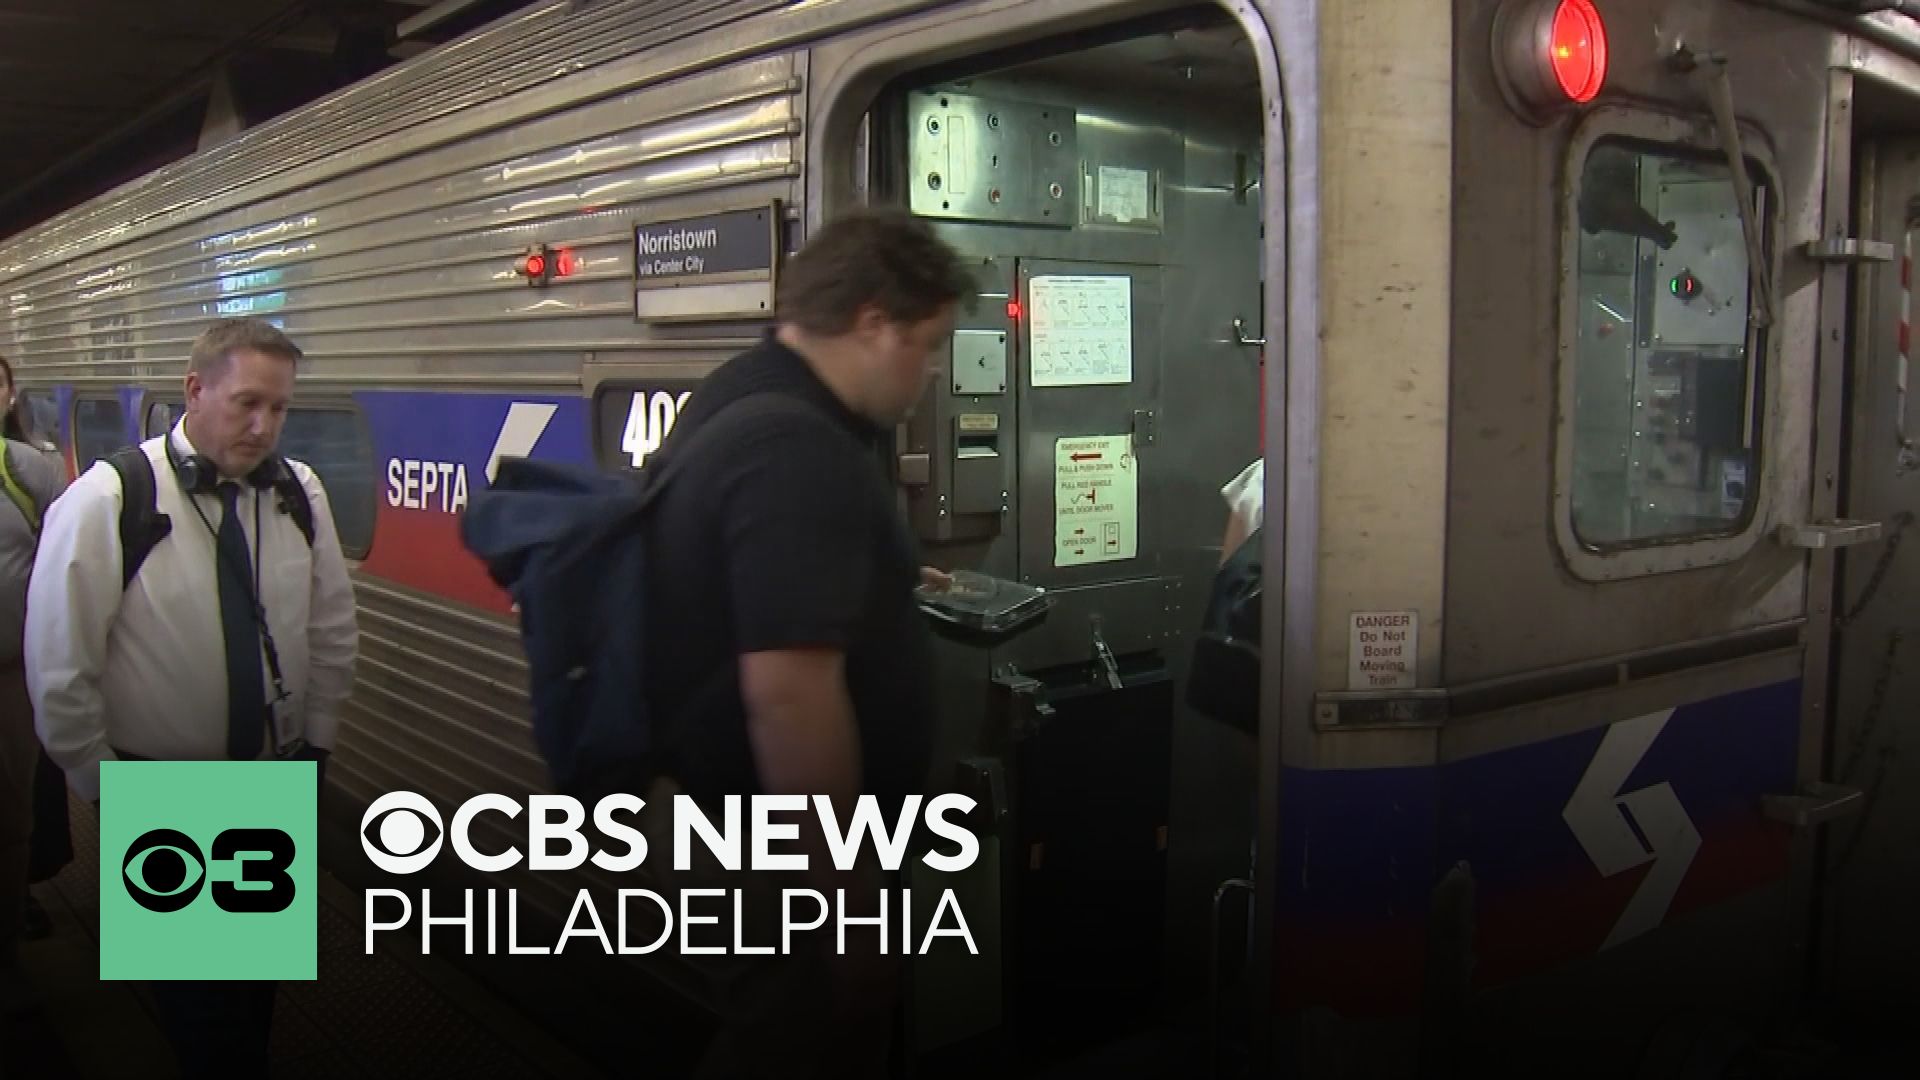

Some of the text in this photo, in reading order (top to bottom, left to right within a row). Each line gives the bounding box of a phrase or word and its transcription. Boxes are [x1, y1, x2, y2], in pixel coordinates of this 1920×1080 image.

[639, 228, 717, 255] Norristown
[640, 255, 704, 276] via Center City
[387, 458, 468, 513] SEPTA
[1356, 615, 1410, 628] DANGER
[1360, 629, 1406, 642] Do Not
[1363, 645, 1402, 657] Board
[1360, 660, 1406, 673] Moving
[1368, 673, 1398, 685] Train
